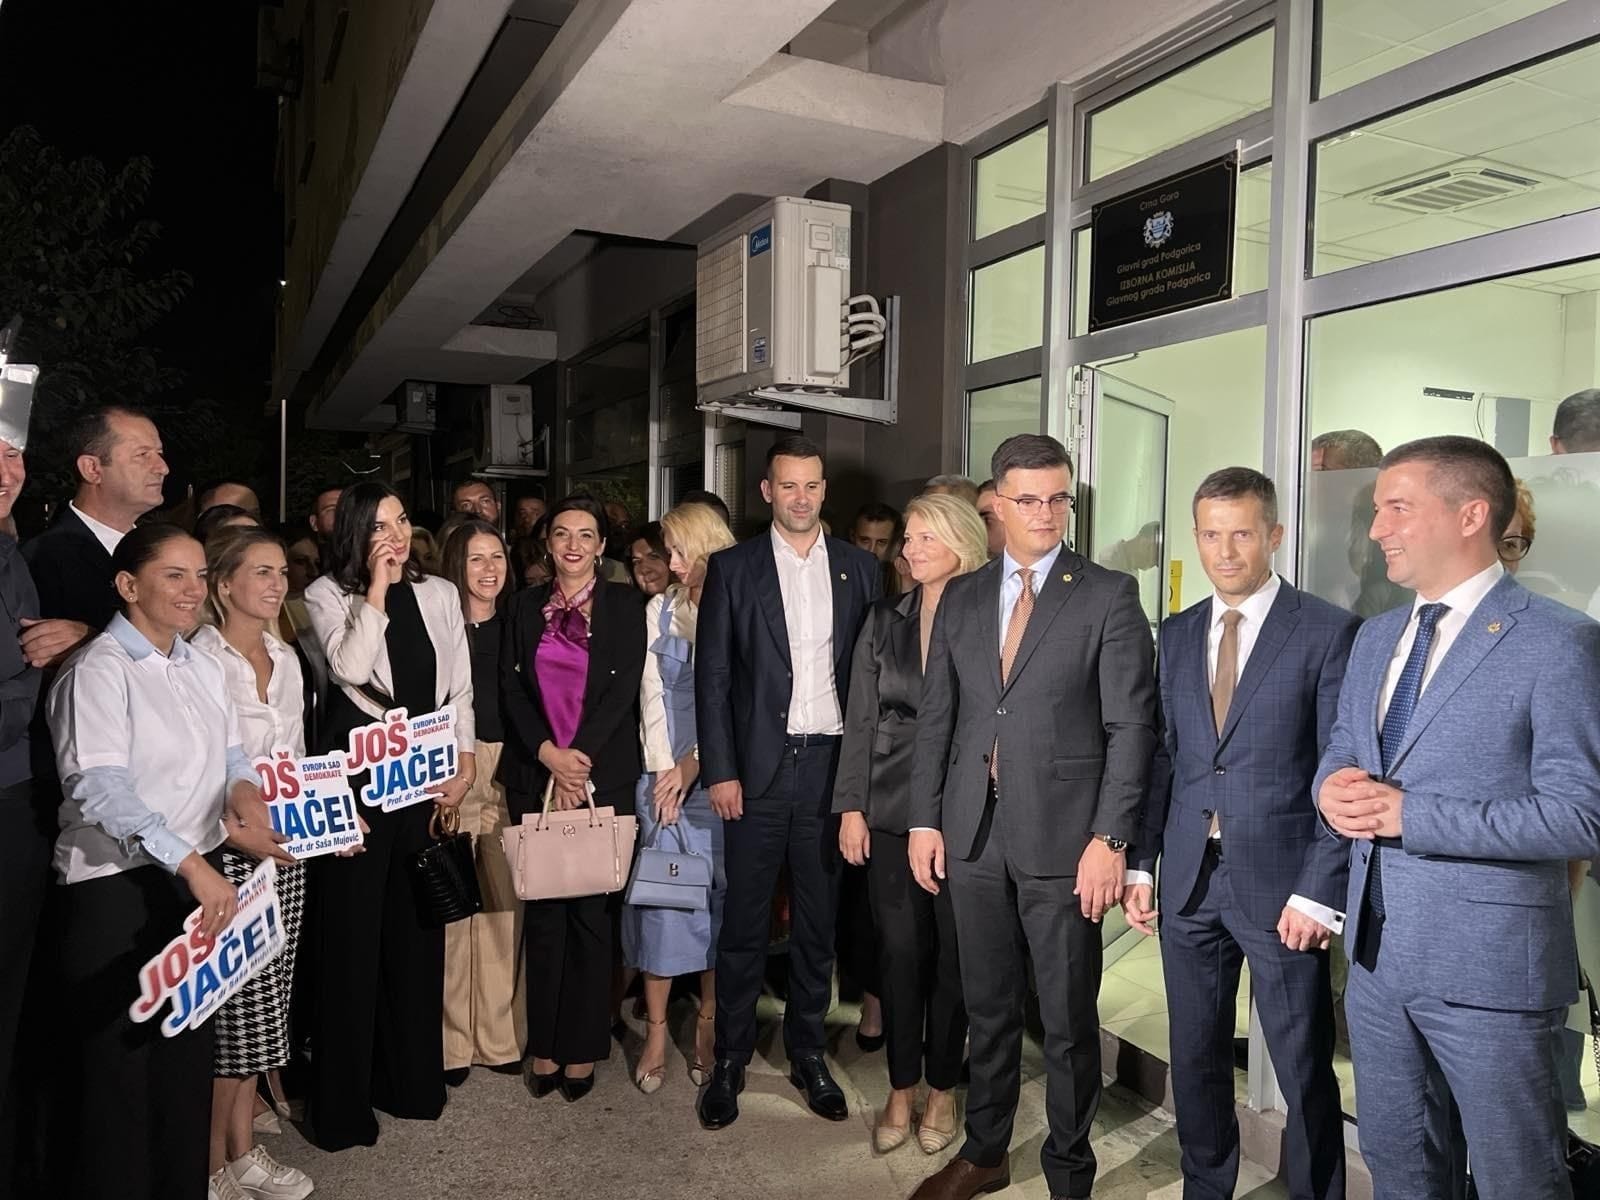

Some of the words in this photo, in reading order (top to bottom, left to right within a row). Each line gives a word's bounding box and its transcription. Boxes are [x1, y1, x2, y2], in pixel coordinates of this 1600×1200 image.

[1139, 198, 1158, 211] Crna
[1160, 191, 1180, 205] Gora
[1117, 260, 1140, 274] Glavni
[1142, 254, 1160, 268] grad
[1161, 242, 1201, 261] Podgorica
[1120, 274, 1154, 291] IZBORNA
[1156, 261, 1196, 280] KOMISIJA
[1106, 291, 1139, 307] Glavnog
[1141, 283, 1165, 299] grada
[1167, 272, 1211, 291] Podgorica
[413, 719, 437, 730] EVROPA
[438, 714, 450, 725] SAD
[413, 723, 450, 738] DEMOKRATE
[348, 713, 408, 769] JOŠ
[255, 752, 300, 802] OŠ
[302, 763, 327, 772] EVROPA
[328, 760, 341, 769] SAD
[304, 770, 342, 782] DEMOKRATE
[367, 744, 454, 801] JAČE!
[387, 796, 403, 807] Prof.
[405, 792, 413, 801] dr
[288, 843, 305, 854] Prof.
[306, 841, 314, 852] dr
[315, 837, 332, 850] Saša
[333, 833, 359, 850] Mujović
[170, 907, 277, 1028] JAČE!
